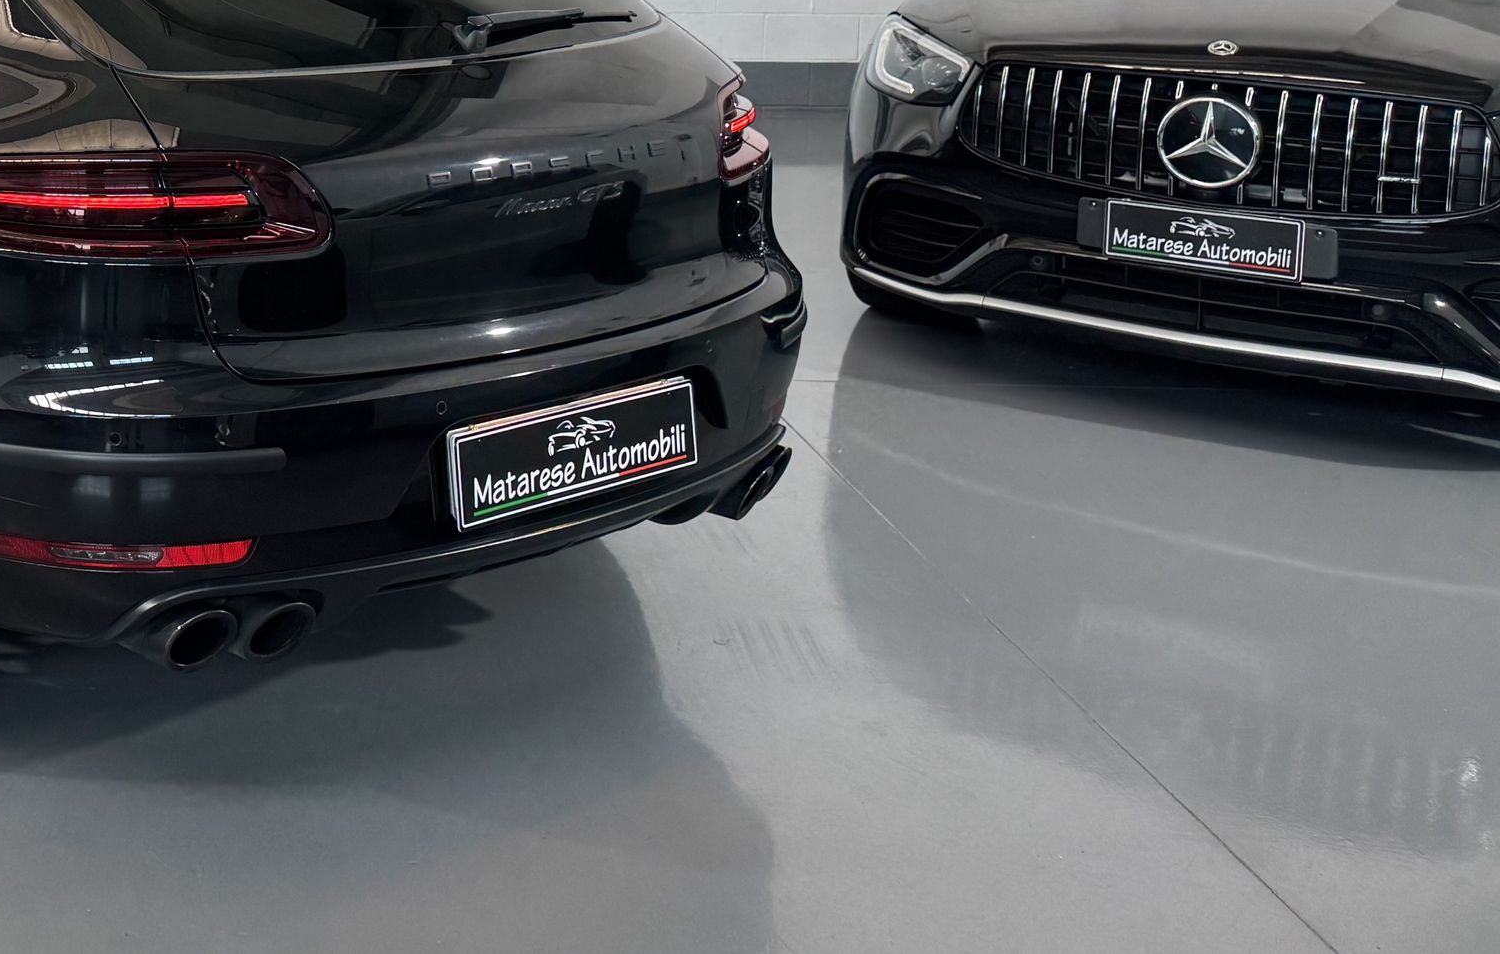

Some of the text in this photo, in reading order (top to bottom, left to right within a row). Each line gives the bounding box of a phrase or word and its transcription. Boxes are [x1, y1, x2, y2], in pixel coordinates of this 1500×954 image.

[427, 140, 667, 188] PORSCHE
[495, 180, 627, 218] Macan GTS
[1113, 227, 1292, 268] Matarese Automobili
[473, 422, 687, 508] Matarese Automobili
